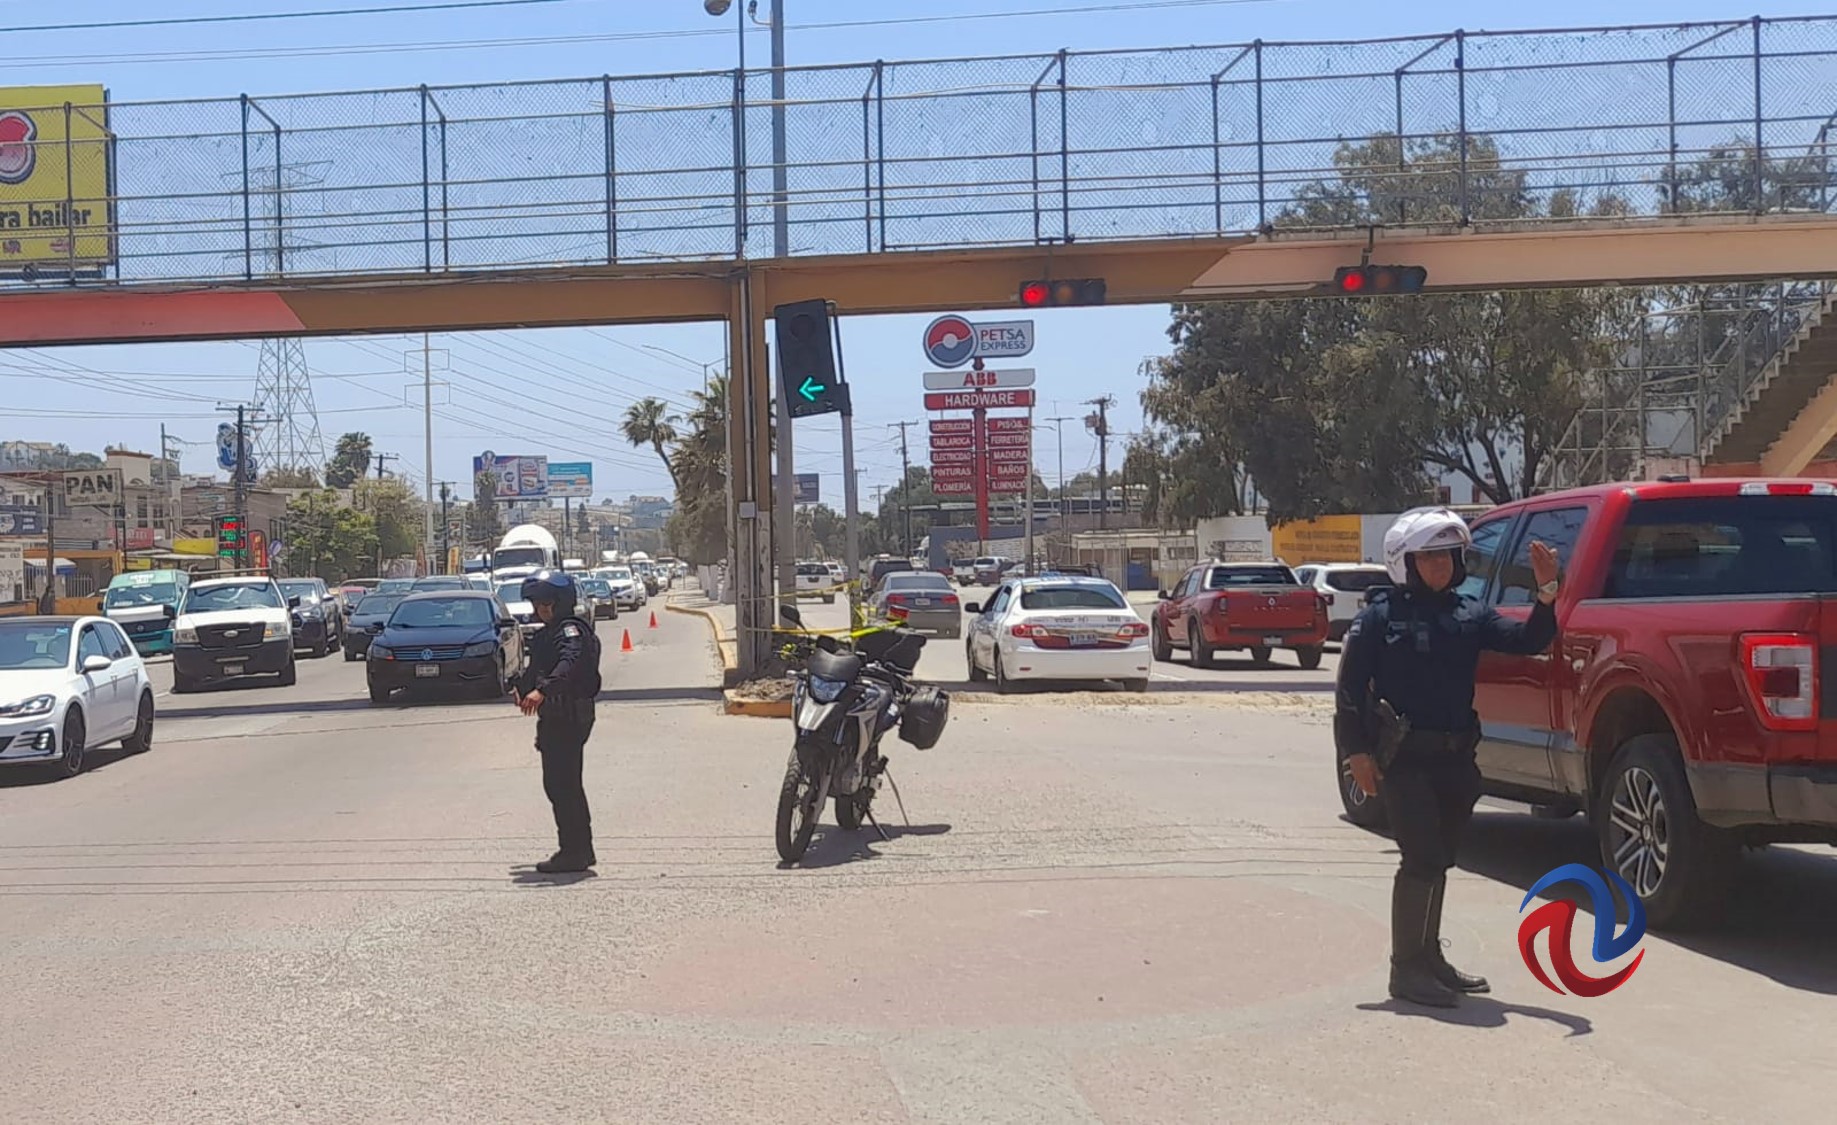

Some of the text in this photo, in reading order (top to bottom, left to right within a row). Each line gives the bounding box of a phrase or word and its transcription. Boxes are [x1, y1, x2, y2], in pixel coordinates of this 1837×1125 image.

[980, 328, 1026, 341] PETSA
[980, 341, 1026, 351] EXPRESS
[962, 372, 998, 387] ABB
[945, 392, 1015, 407] HARDWARE
[933, 437, 972, 446] TABLAROCA
[993, 450, 1028, 460] MADERA
[933, 466, 972, 476] PINTURAS
[997, 464, 1025, 475] BAÑOS
[66, 474, 113, 496] PAN
[933, 480, 972, 491] PLOMERÍA
